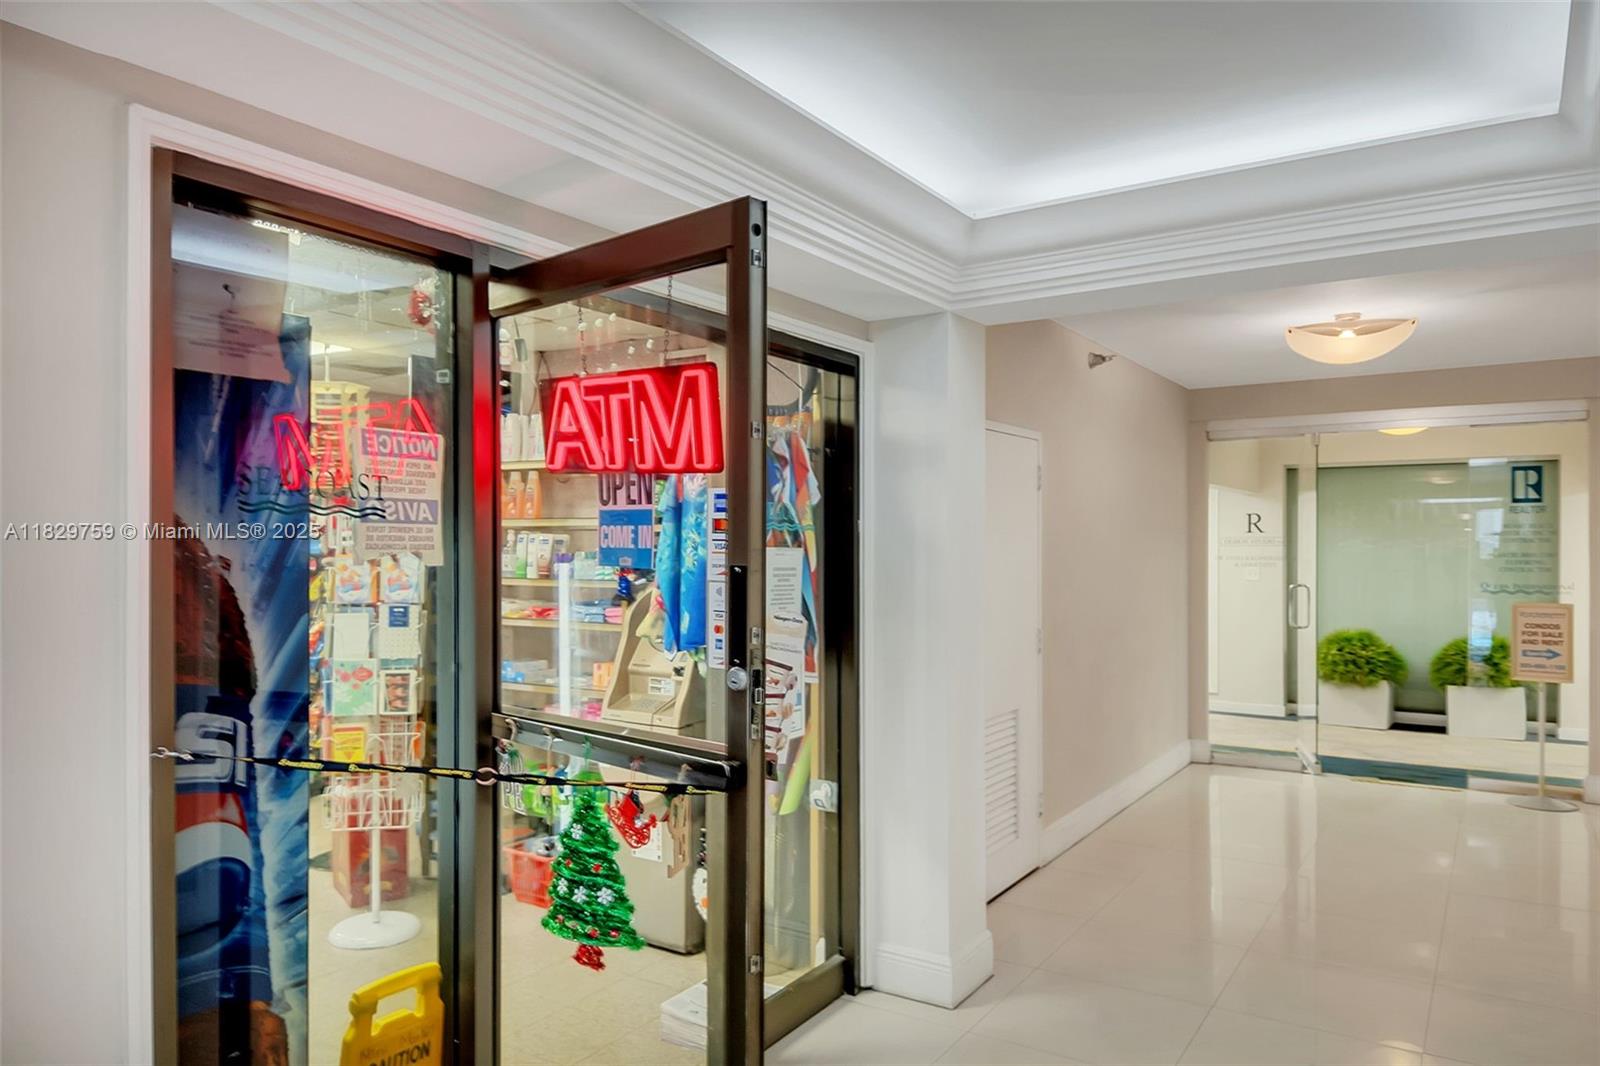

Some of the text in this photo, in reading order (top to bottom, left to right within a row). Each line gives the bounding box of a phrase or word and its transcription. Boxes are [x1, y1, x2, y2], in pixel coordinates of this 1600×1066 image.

[545, 369, 715, 470] ATM
[598, 472, 653, 506] OPEN
[1246, 512, 1264, 534] R
[600, 524, 652, 549] COME IN
[1524, 622, 1561, 630] CONDOS
[369, 1040, 431, 1066] UTION
